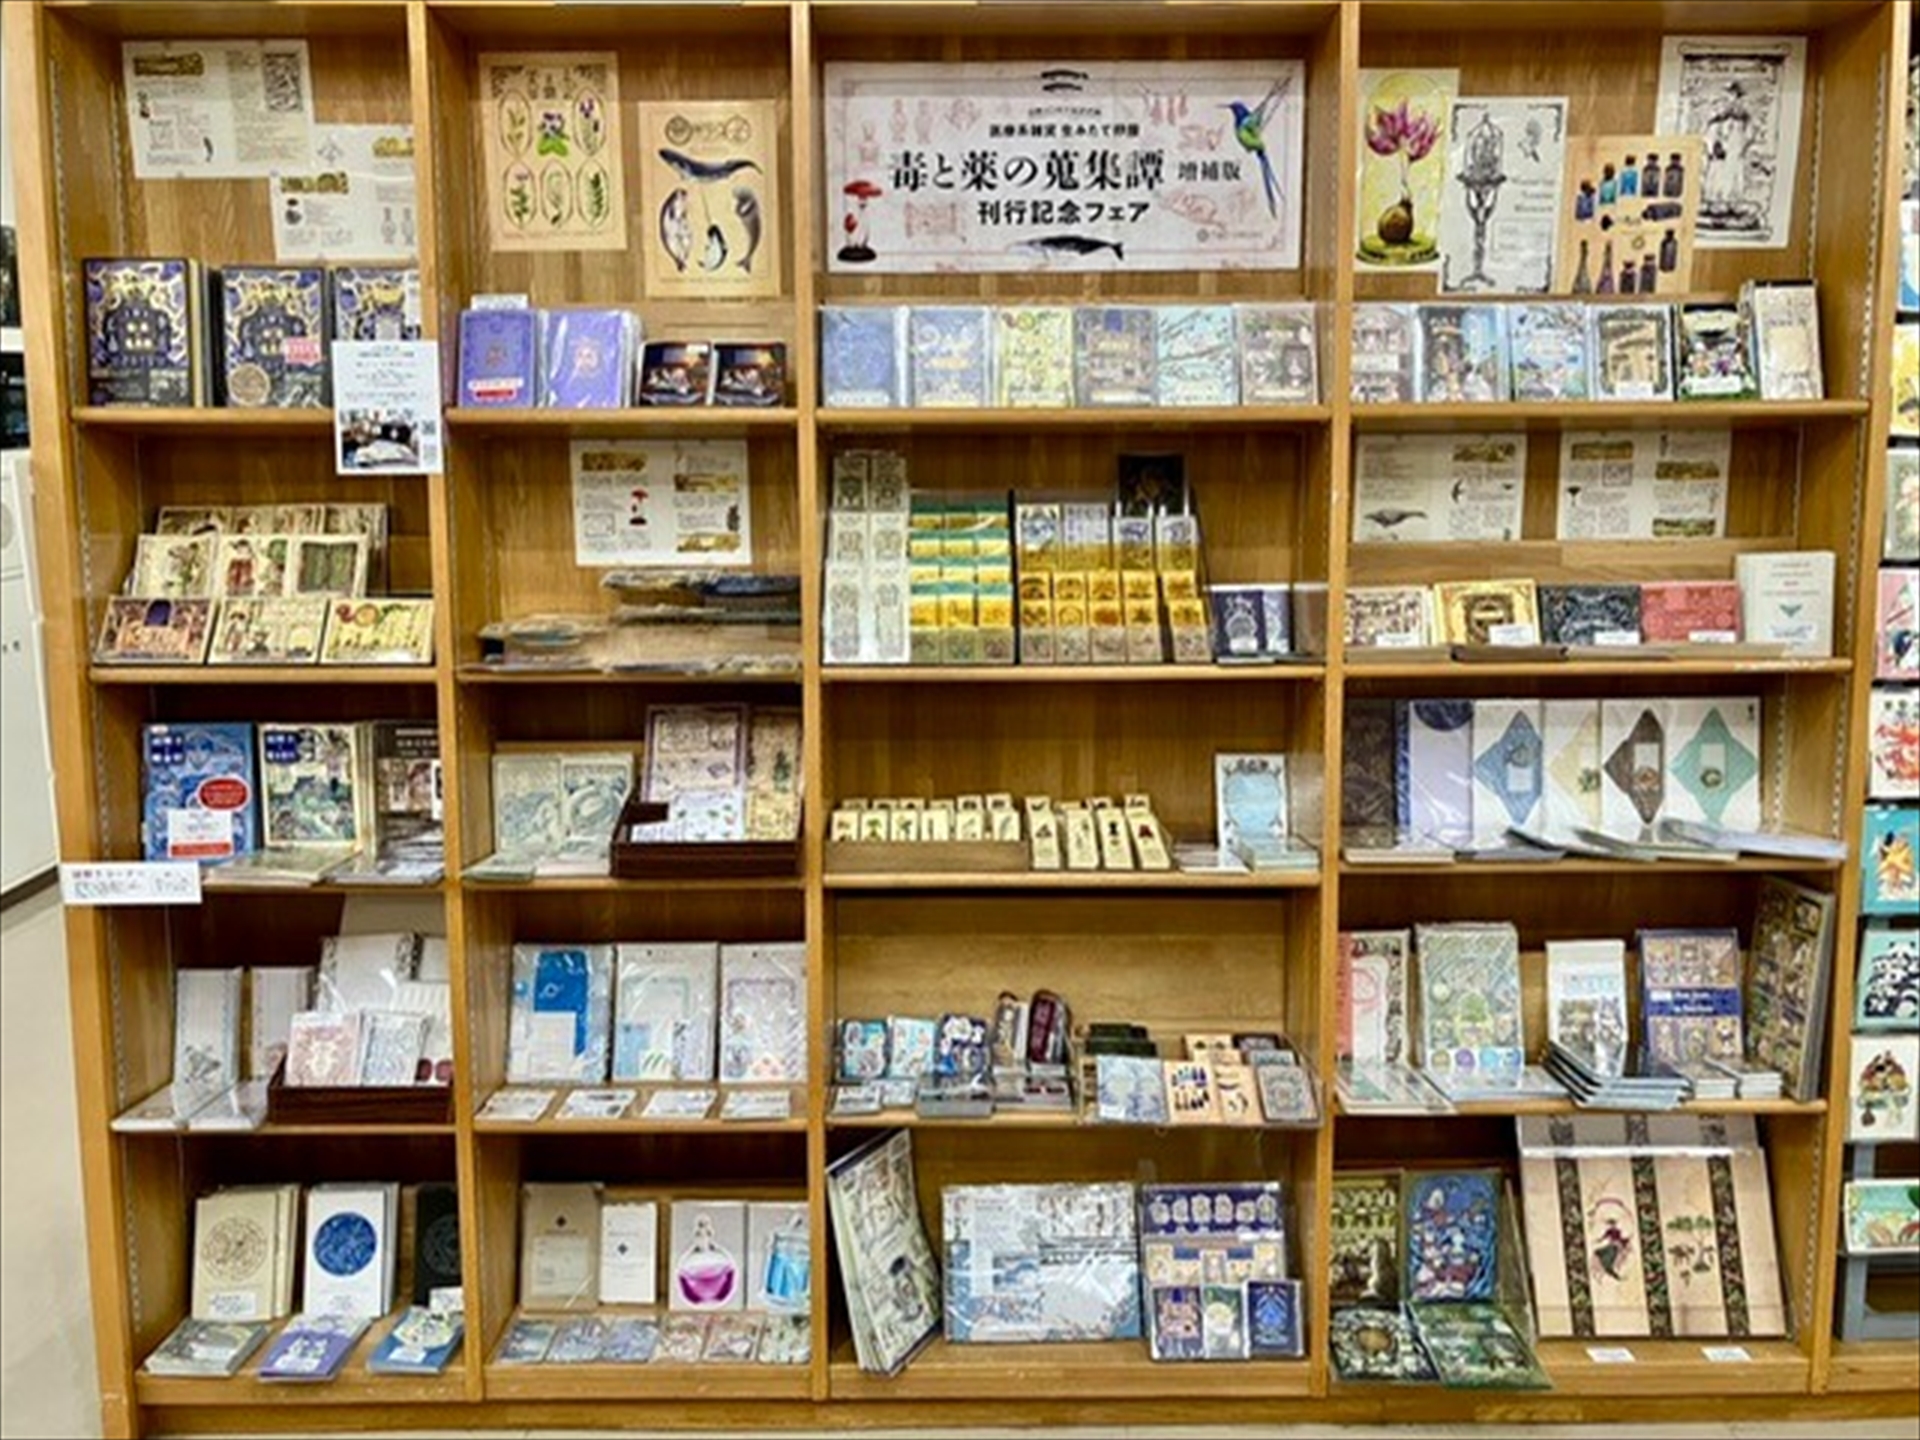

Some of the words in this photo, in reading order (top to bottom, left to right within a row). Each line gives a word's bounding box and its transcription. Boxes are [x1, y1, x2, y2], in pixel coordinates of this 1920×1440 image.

[892, 149, 1165, 192] 毒と薬の蒐集譚
[1178, 160, 1241, 182] 増補版
[978, 200, 1150, 225] 刊行記念フェア
